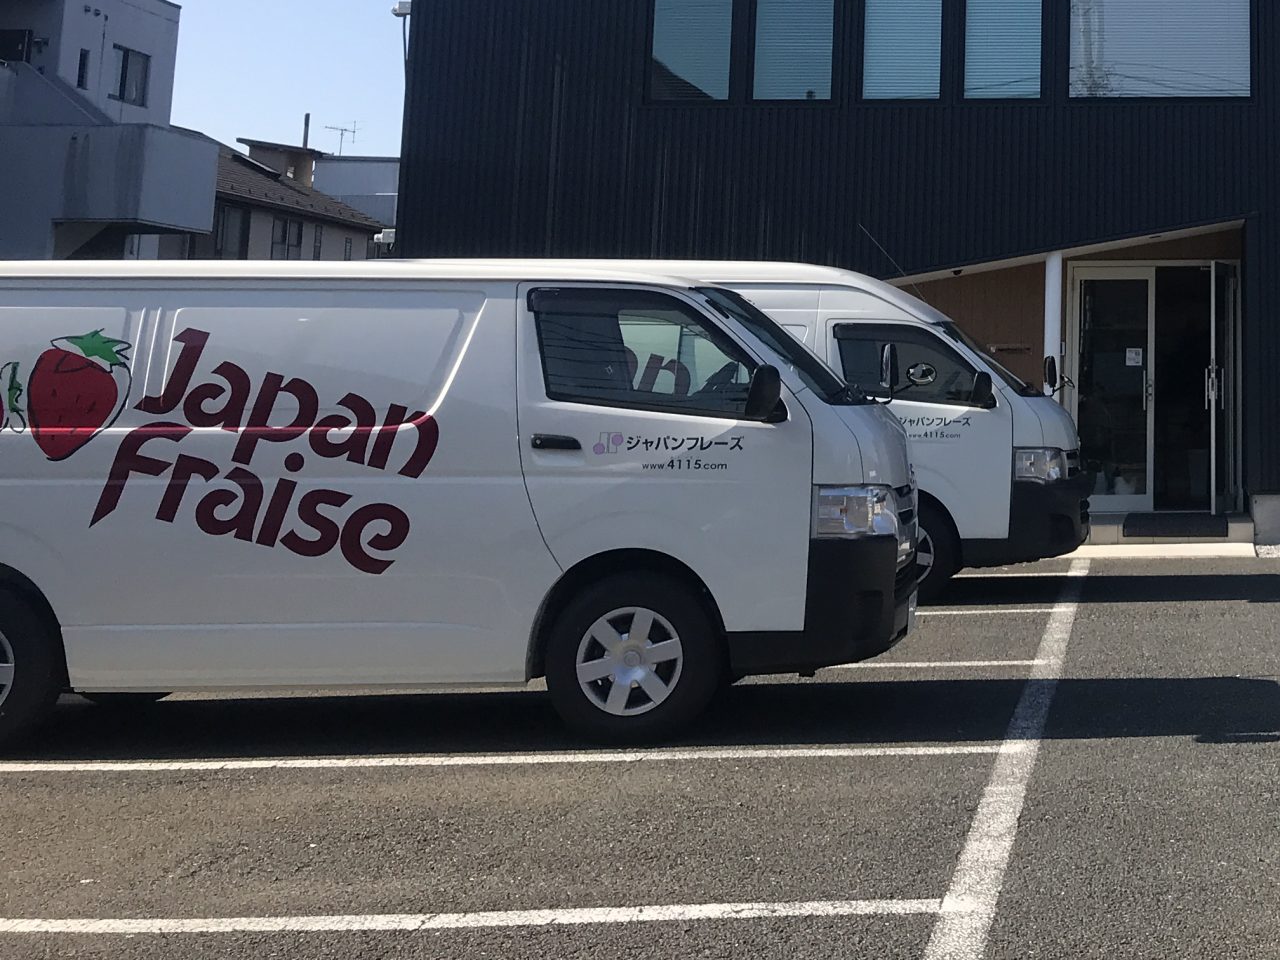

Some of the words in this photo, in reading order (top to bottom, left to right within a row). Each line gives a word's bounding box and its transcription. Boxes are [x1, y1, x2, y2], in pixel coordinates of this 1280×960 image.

[134, 327, 440, 479] Japan
[626, 435, 745, 451] ジャパンフレーズ
